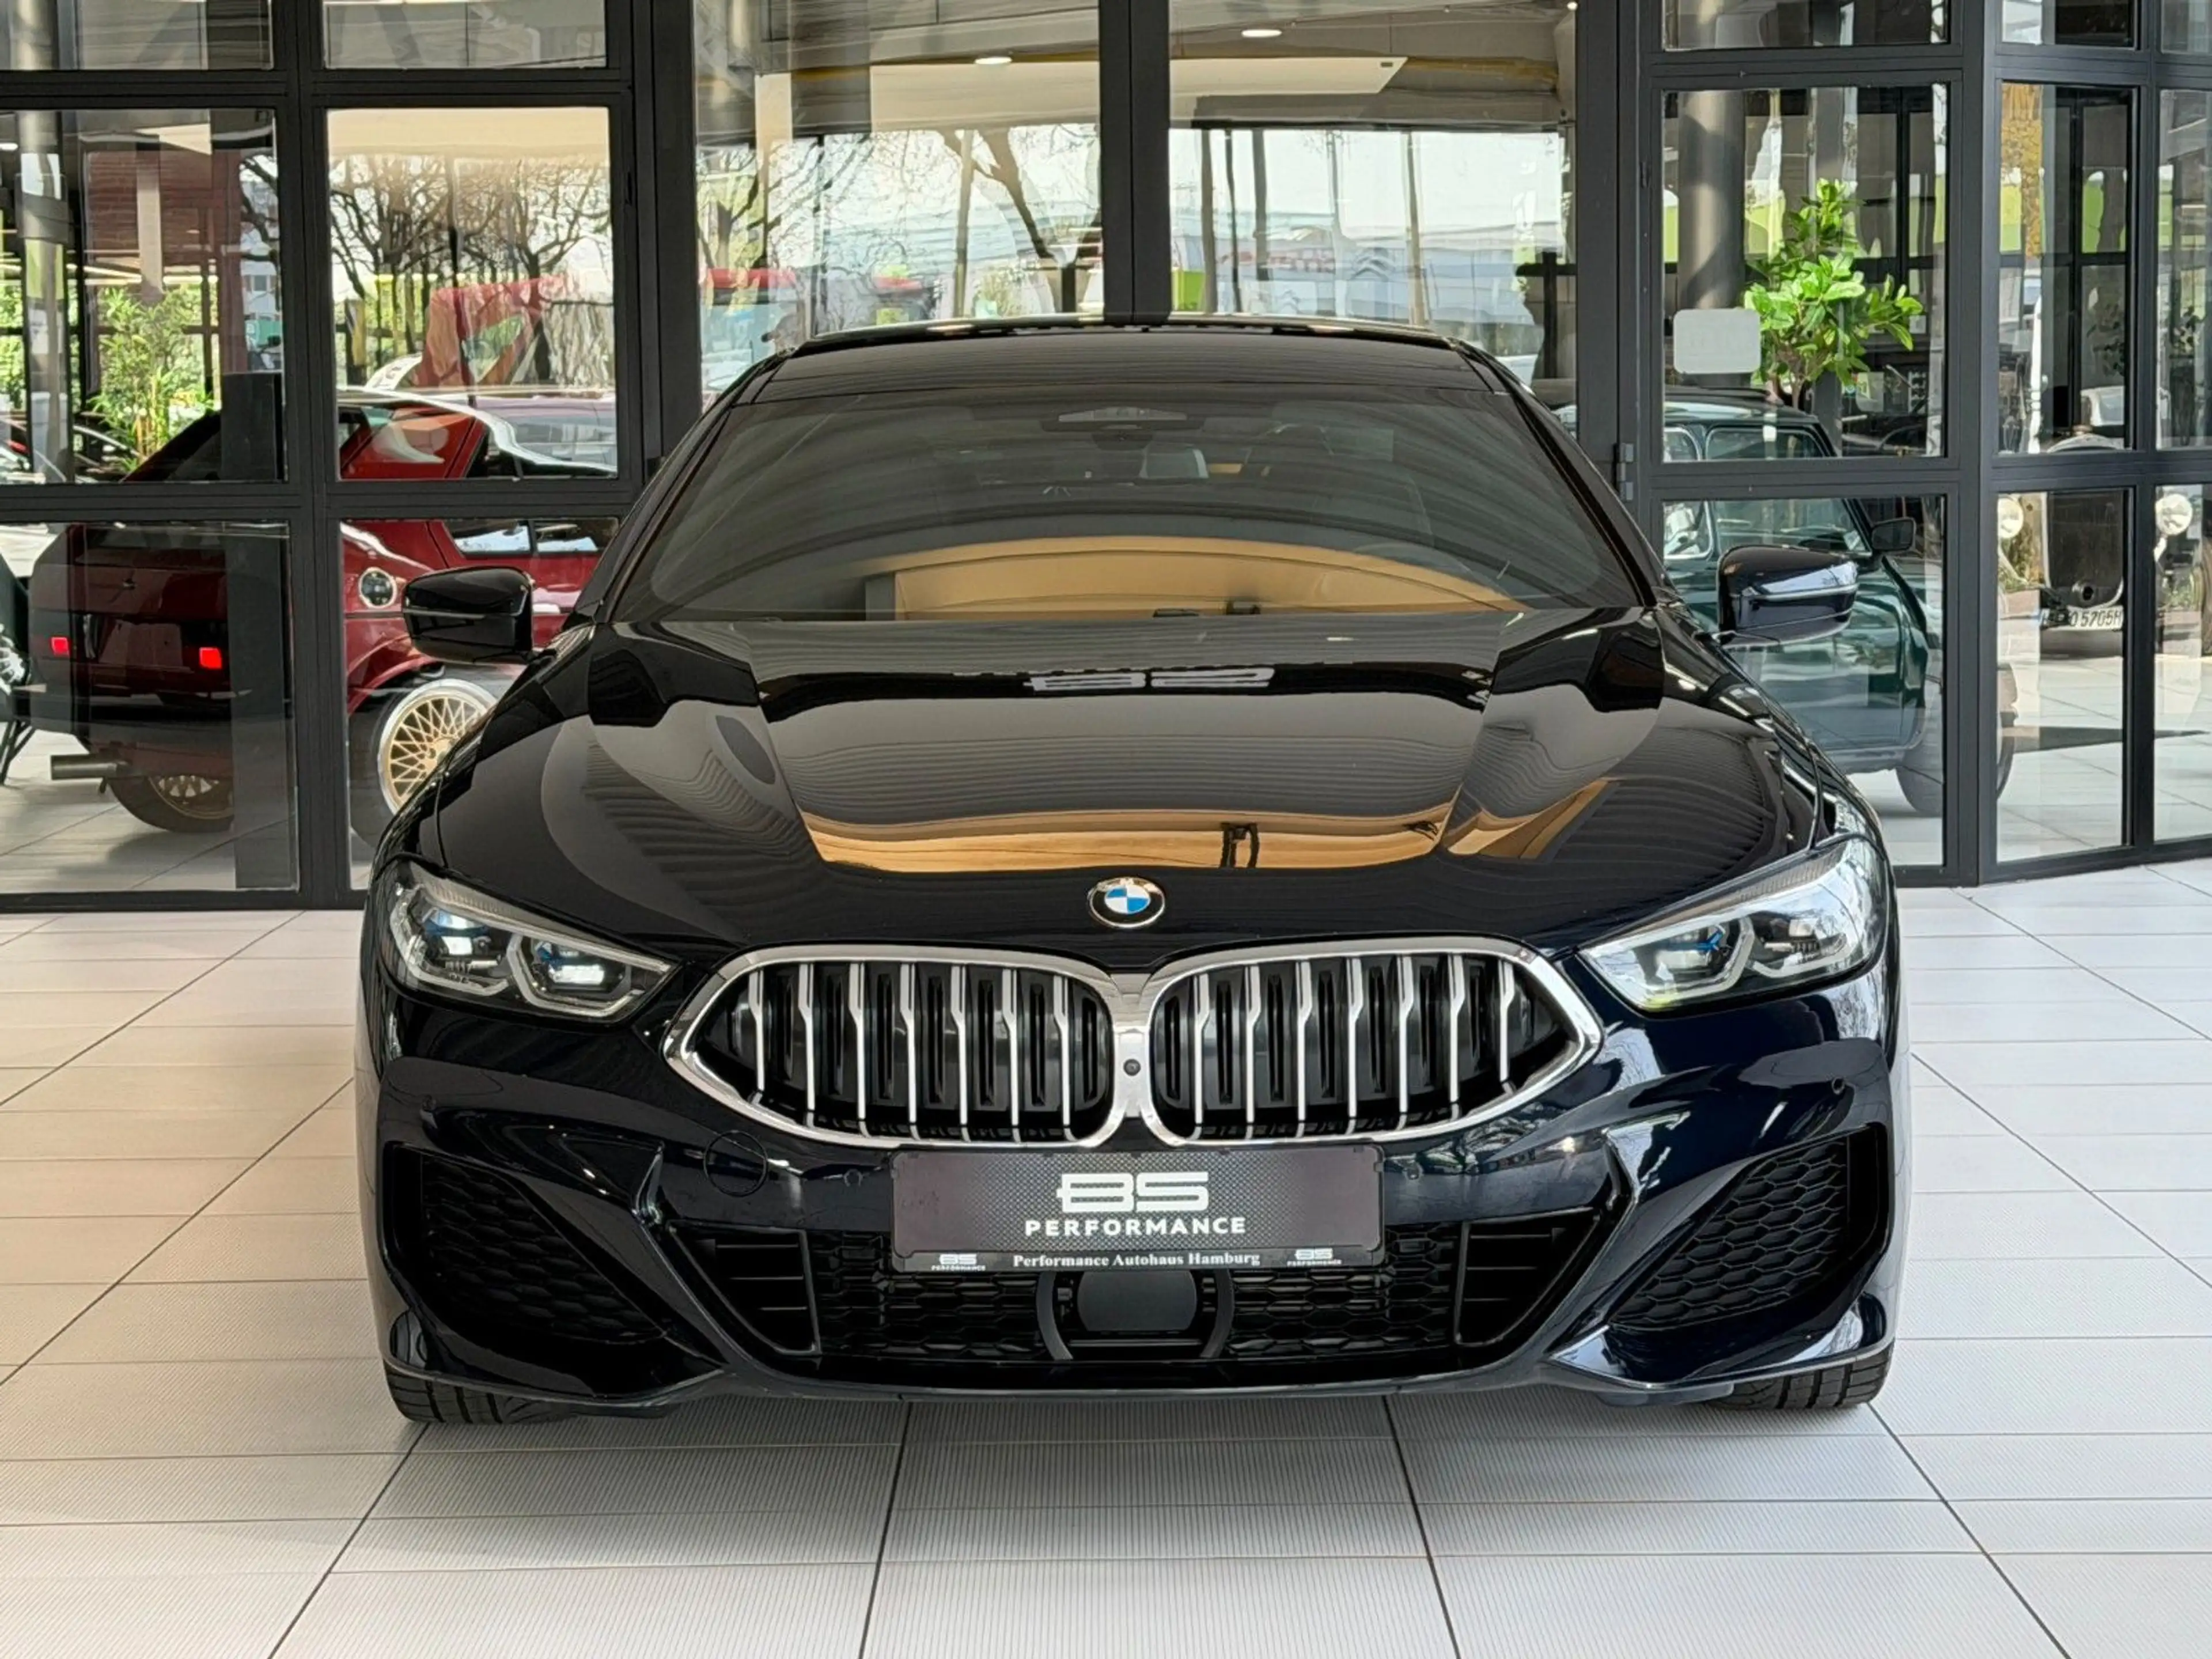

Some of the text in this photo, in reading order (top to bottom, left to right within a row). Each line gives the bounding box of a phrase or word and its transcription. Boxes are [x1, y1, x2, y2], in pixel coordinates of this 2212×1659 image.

[1025, 1217, 1245, 1236] PERFORMANCE
[1013, 1252, 1260, 1267] Performance Autohaus Hamburg
